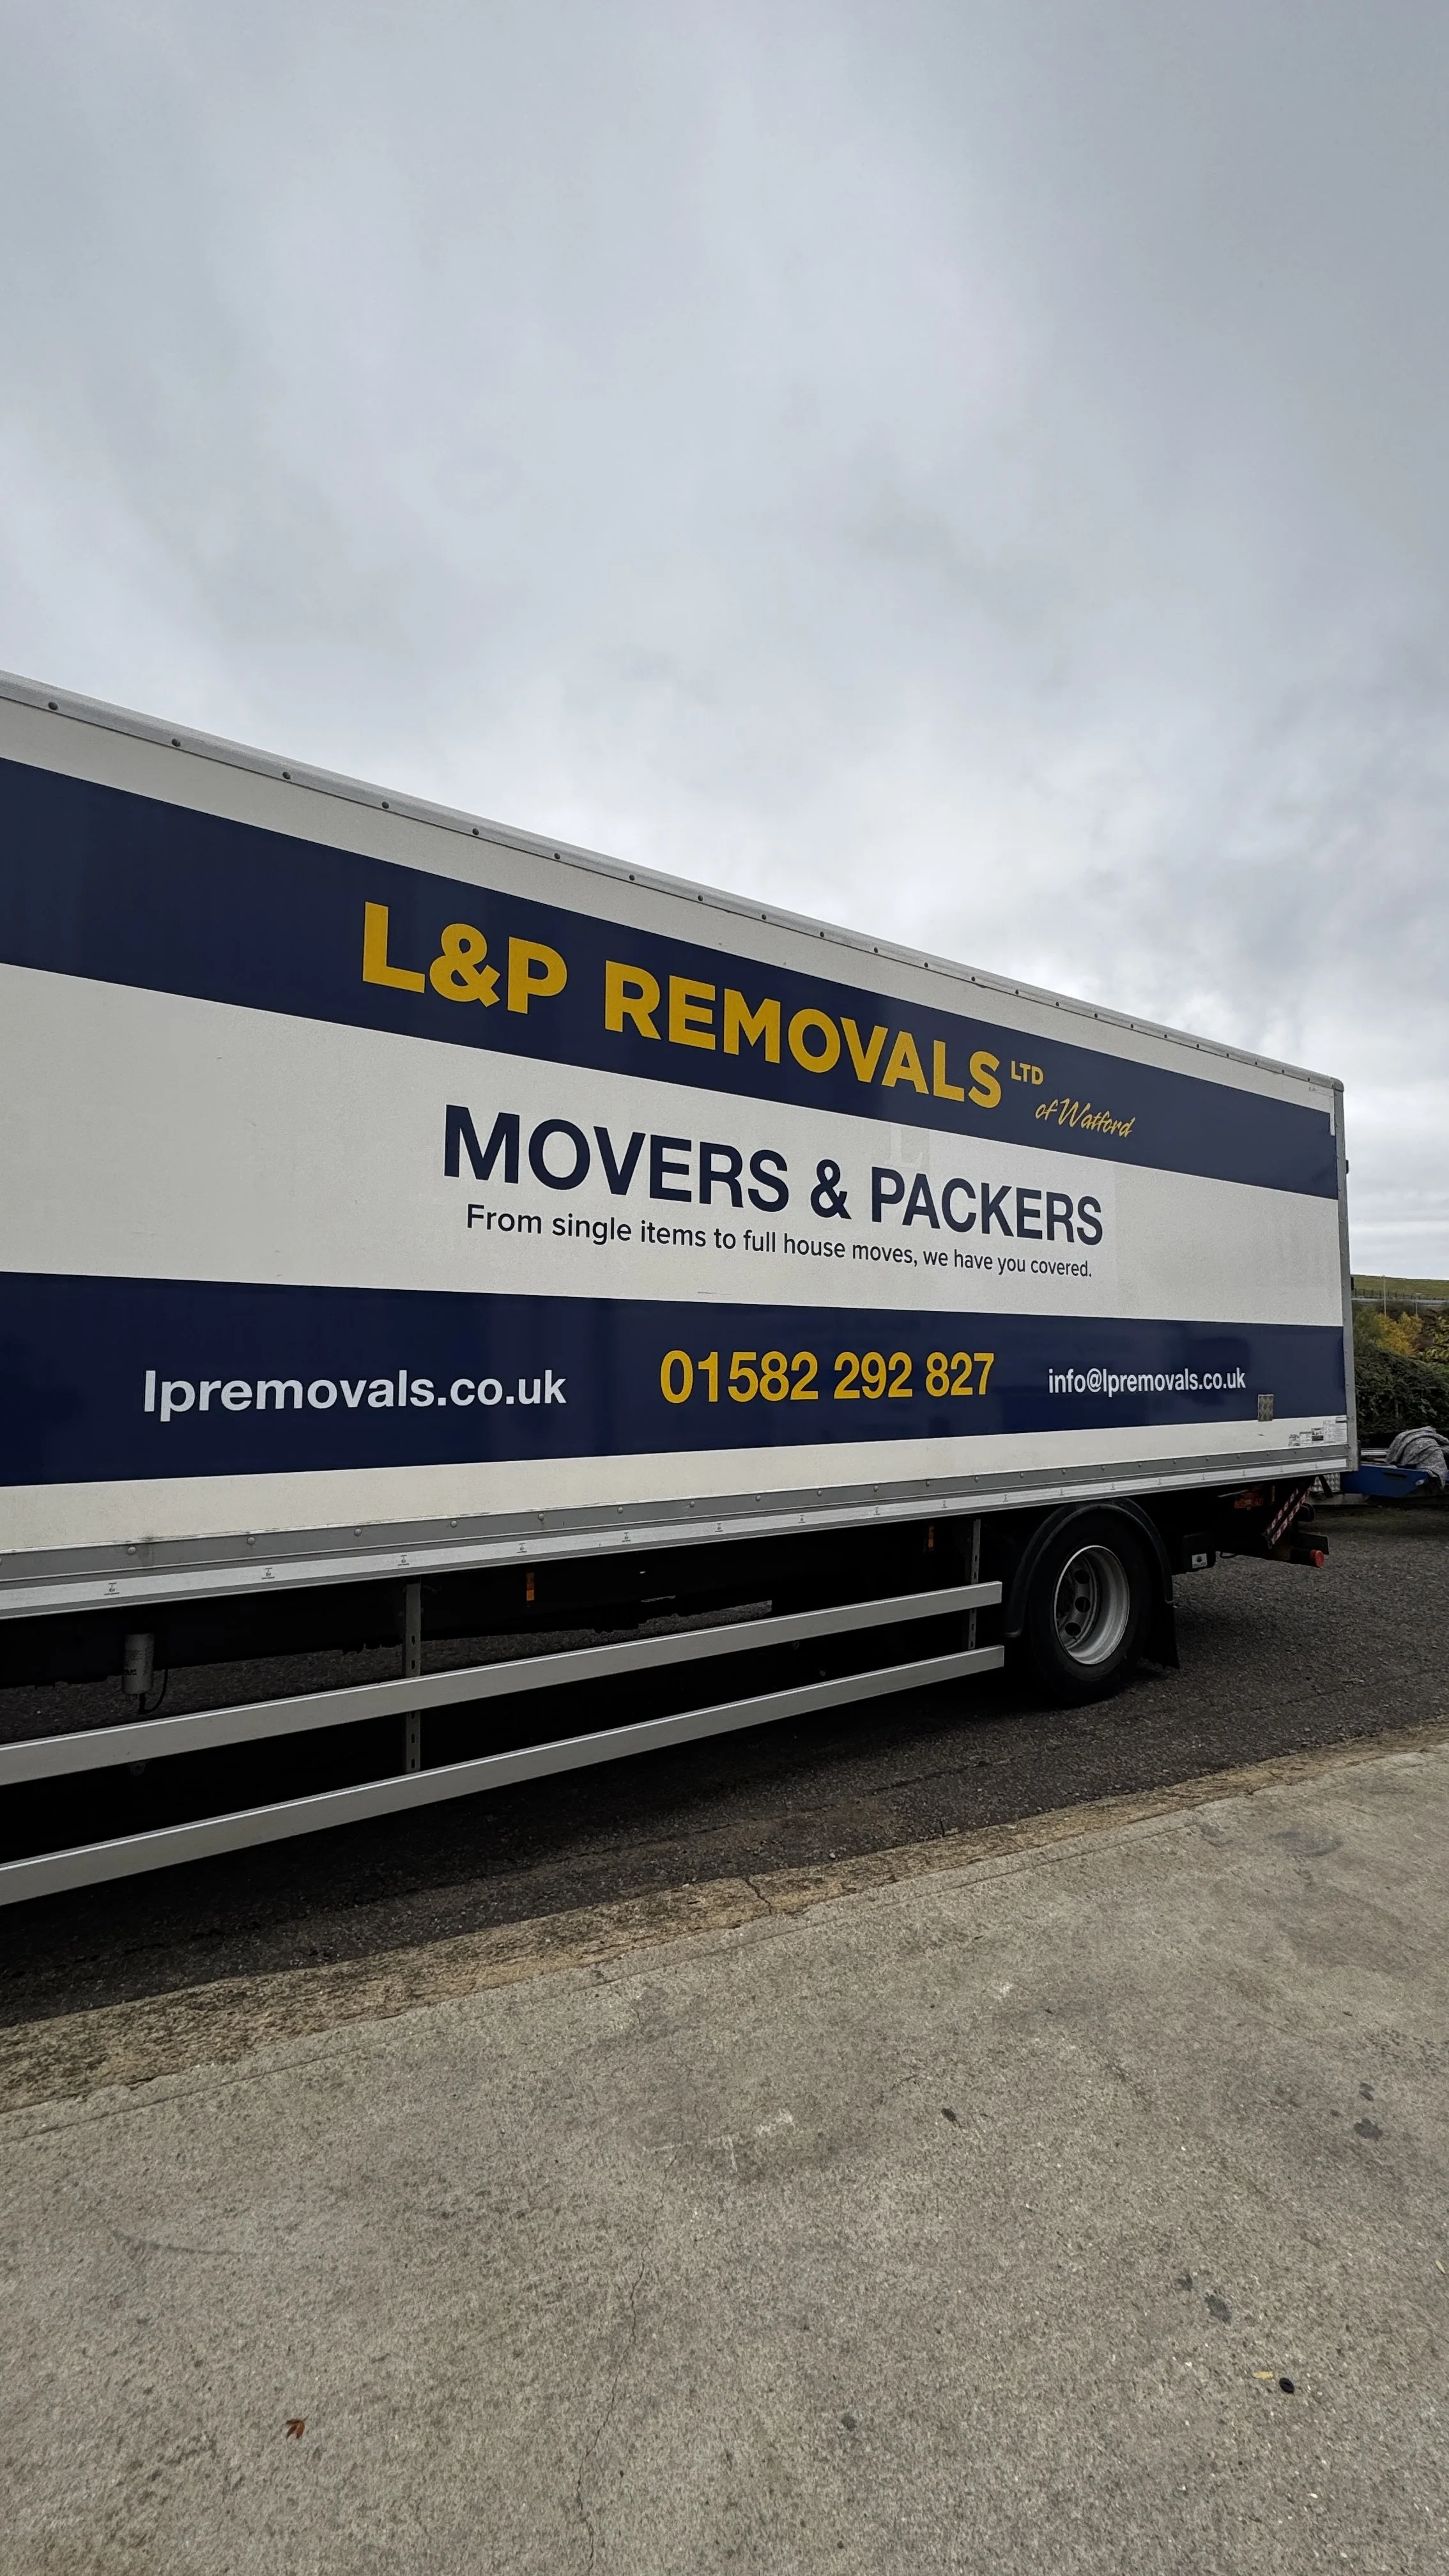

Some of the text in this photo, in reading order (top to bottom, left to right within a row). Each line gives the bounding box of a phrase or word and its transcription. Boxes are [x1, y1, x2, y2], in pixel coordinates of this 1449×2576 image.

[362, 901, 1045, 1108] L&P REMOVALS LTD
[1035, 1098, 1136, 1138] of Watford
[443, 1104, 1103, 1246] MOVERS & PACKERS
[467, 1204, 1092, 1278] From single items to full house moves, we have you covered.
[144, 1369, 567, 1423] lpremovals.co.uk
[660, 1349, 995, 1404] 01582 292 827
[1048, 1367, 1246, 1398] info@lpremovals.co.uk
